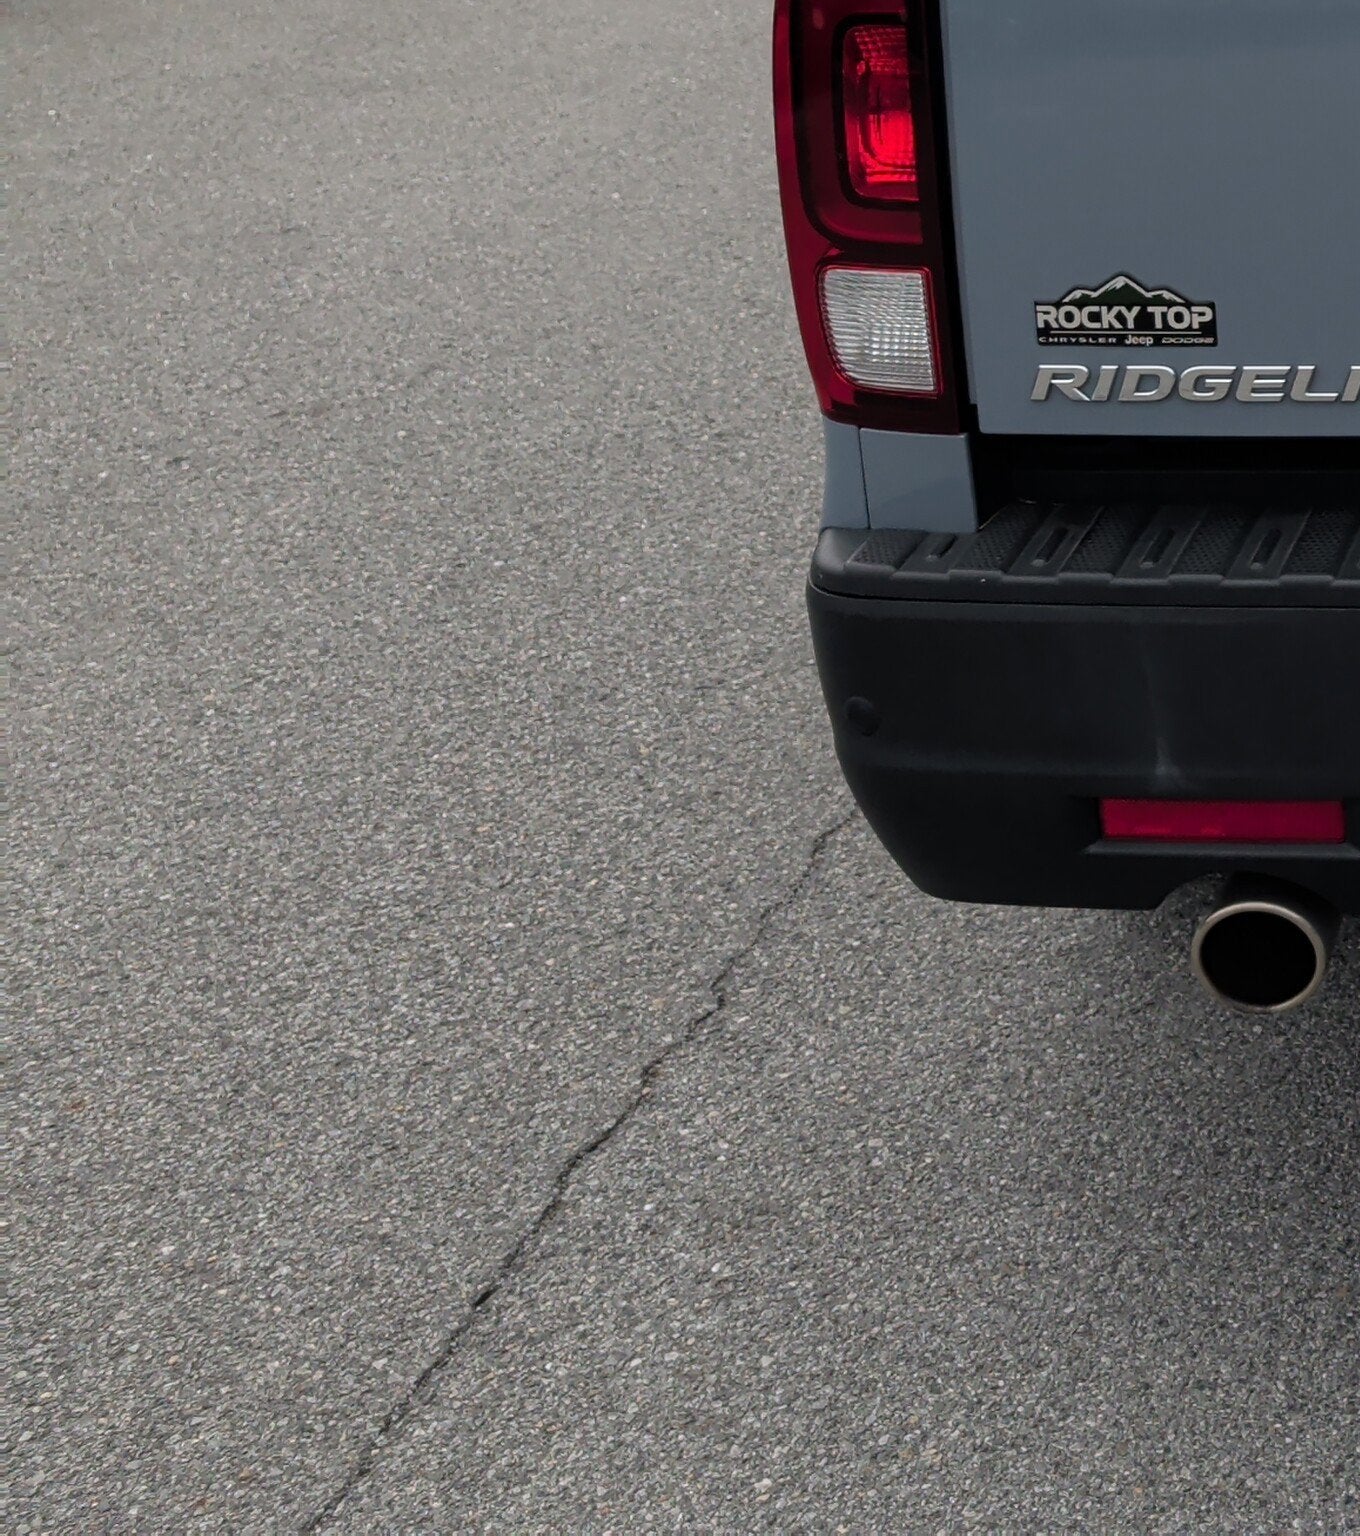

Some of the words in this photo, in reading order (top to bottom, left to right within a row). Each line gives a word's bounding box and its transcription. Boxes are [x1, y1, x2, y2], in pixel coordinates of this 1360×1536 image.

[1036, 305, 1141, 329] ROCKY
[1147, 305, 1213, 330] TOP
[1038, 336, 1117, 344] CHRYSLER
[1125, 335, 1153, 346] Jeep
